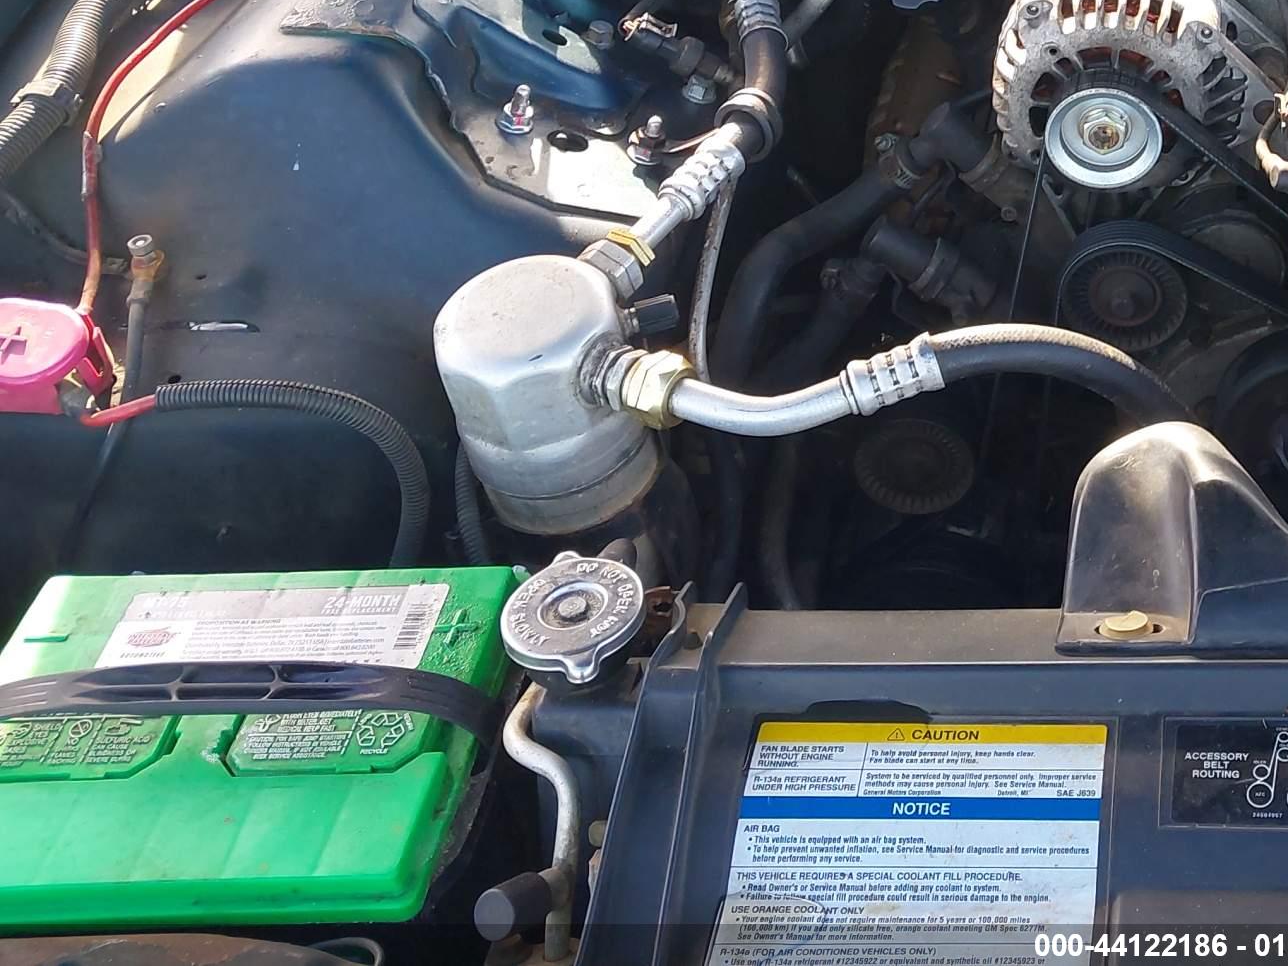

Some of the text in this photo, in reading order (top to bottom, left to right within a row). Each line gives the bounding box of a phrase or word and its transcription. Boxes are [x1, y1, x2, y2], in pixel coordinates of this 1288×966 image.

[576, 562, 633, 638] DO NOT OPEN HOT
[510, 579, 550, 646] OPEN SLOWLY
[911, 730, 979, 741] CAUTION
[880, 750, 896, 759] help
[917, 750, 949, 759] personal
[949, 750, 973, 759] injury,
[974, 750, 991, 759] keep
[757, 760, 800, 768] RUNNING.
[1203, 761, 1229, 769] BELT
[866, 772, 892, 782] System
[942, 773, 950, 782] by
[950, 773, 982, 782] qualified
[983, 773, 1017, 782] personnel
[1018, 773, 1034, 782] only.
[1038, 773, 1069, 782] Improper
[1192, 770, 1239, 778] ROUTING
[808, 784, 858, 792] PRESSURE
[935, 781, 966, 789] personal
[968, 781, 989, 789] injury.
[890, 803, 953, 815] NOTICE
[744, 825, 779, 833] AIR BAG
[807, 836, 841, 846] equipped
[842, 836, 859, 844] with
[871, 836, 881, 844] air
[883, 836, 896, 846] bag
[898, 836, 928, 846] system.
[763, 845, 778, 854] help
[781, 845, 809, 854] prevent
[808, 845, 844, 853] unwanted
[846, 845, 879, 854] inflation,
[966, 846, 1004, 855] diagnostic
[1049, 846, 1089, 855] procedures
[752, 854, 775, 862] before
[777, 855, 817, 864] performing
[736, 872, 756, 880] THIS
[758, 872, 796, 880] VEHICLE
[799, 872, 846, 880] REQUIRES
[856, 873, 895, 881] SPECIAL
[897, 873, 940, 881] COOLANT
[943, 873, 962, 881] FILL
[964, 873, 1023, 881] PROCEDURE.
[746, 883, 766, 891] Read
[767, 883, 798, 891] Owner's
[894, 884, 918, 893] adding
[934, 884, 962, 892] coolant
[964, 884, 971, 892] to
[973, 884, 1001, 894] system.
[730, 906, 863, 915] USE ORANGE COOLANT ONLY
[720, 948, 750, 956] R-134a
[752, 948, 775, 956] (FOR
[776, 948, 794, 956] AIR
[794, 948, 859, 956] CONDITIONED
[861, 948, 906, 956] VEHICLES
